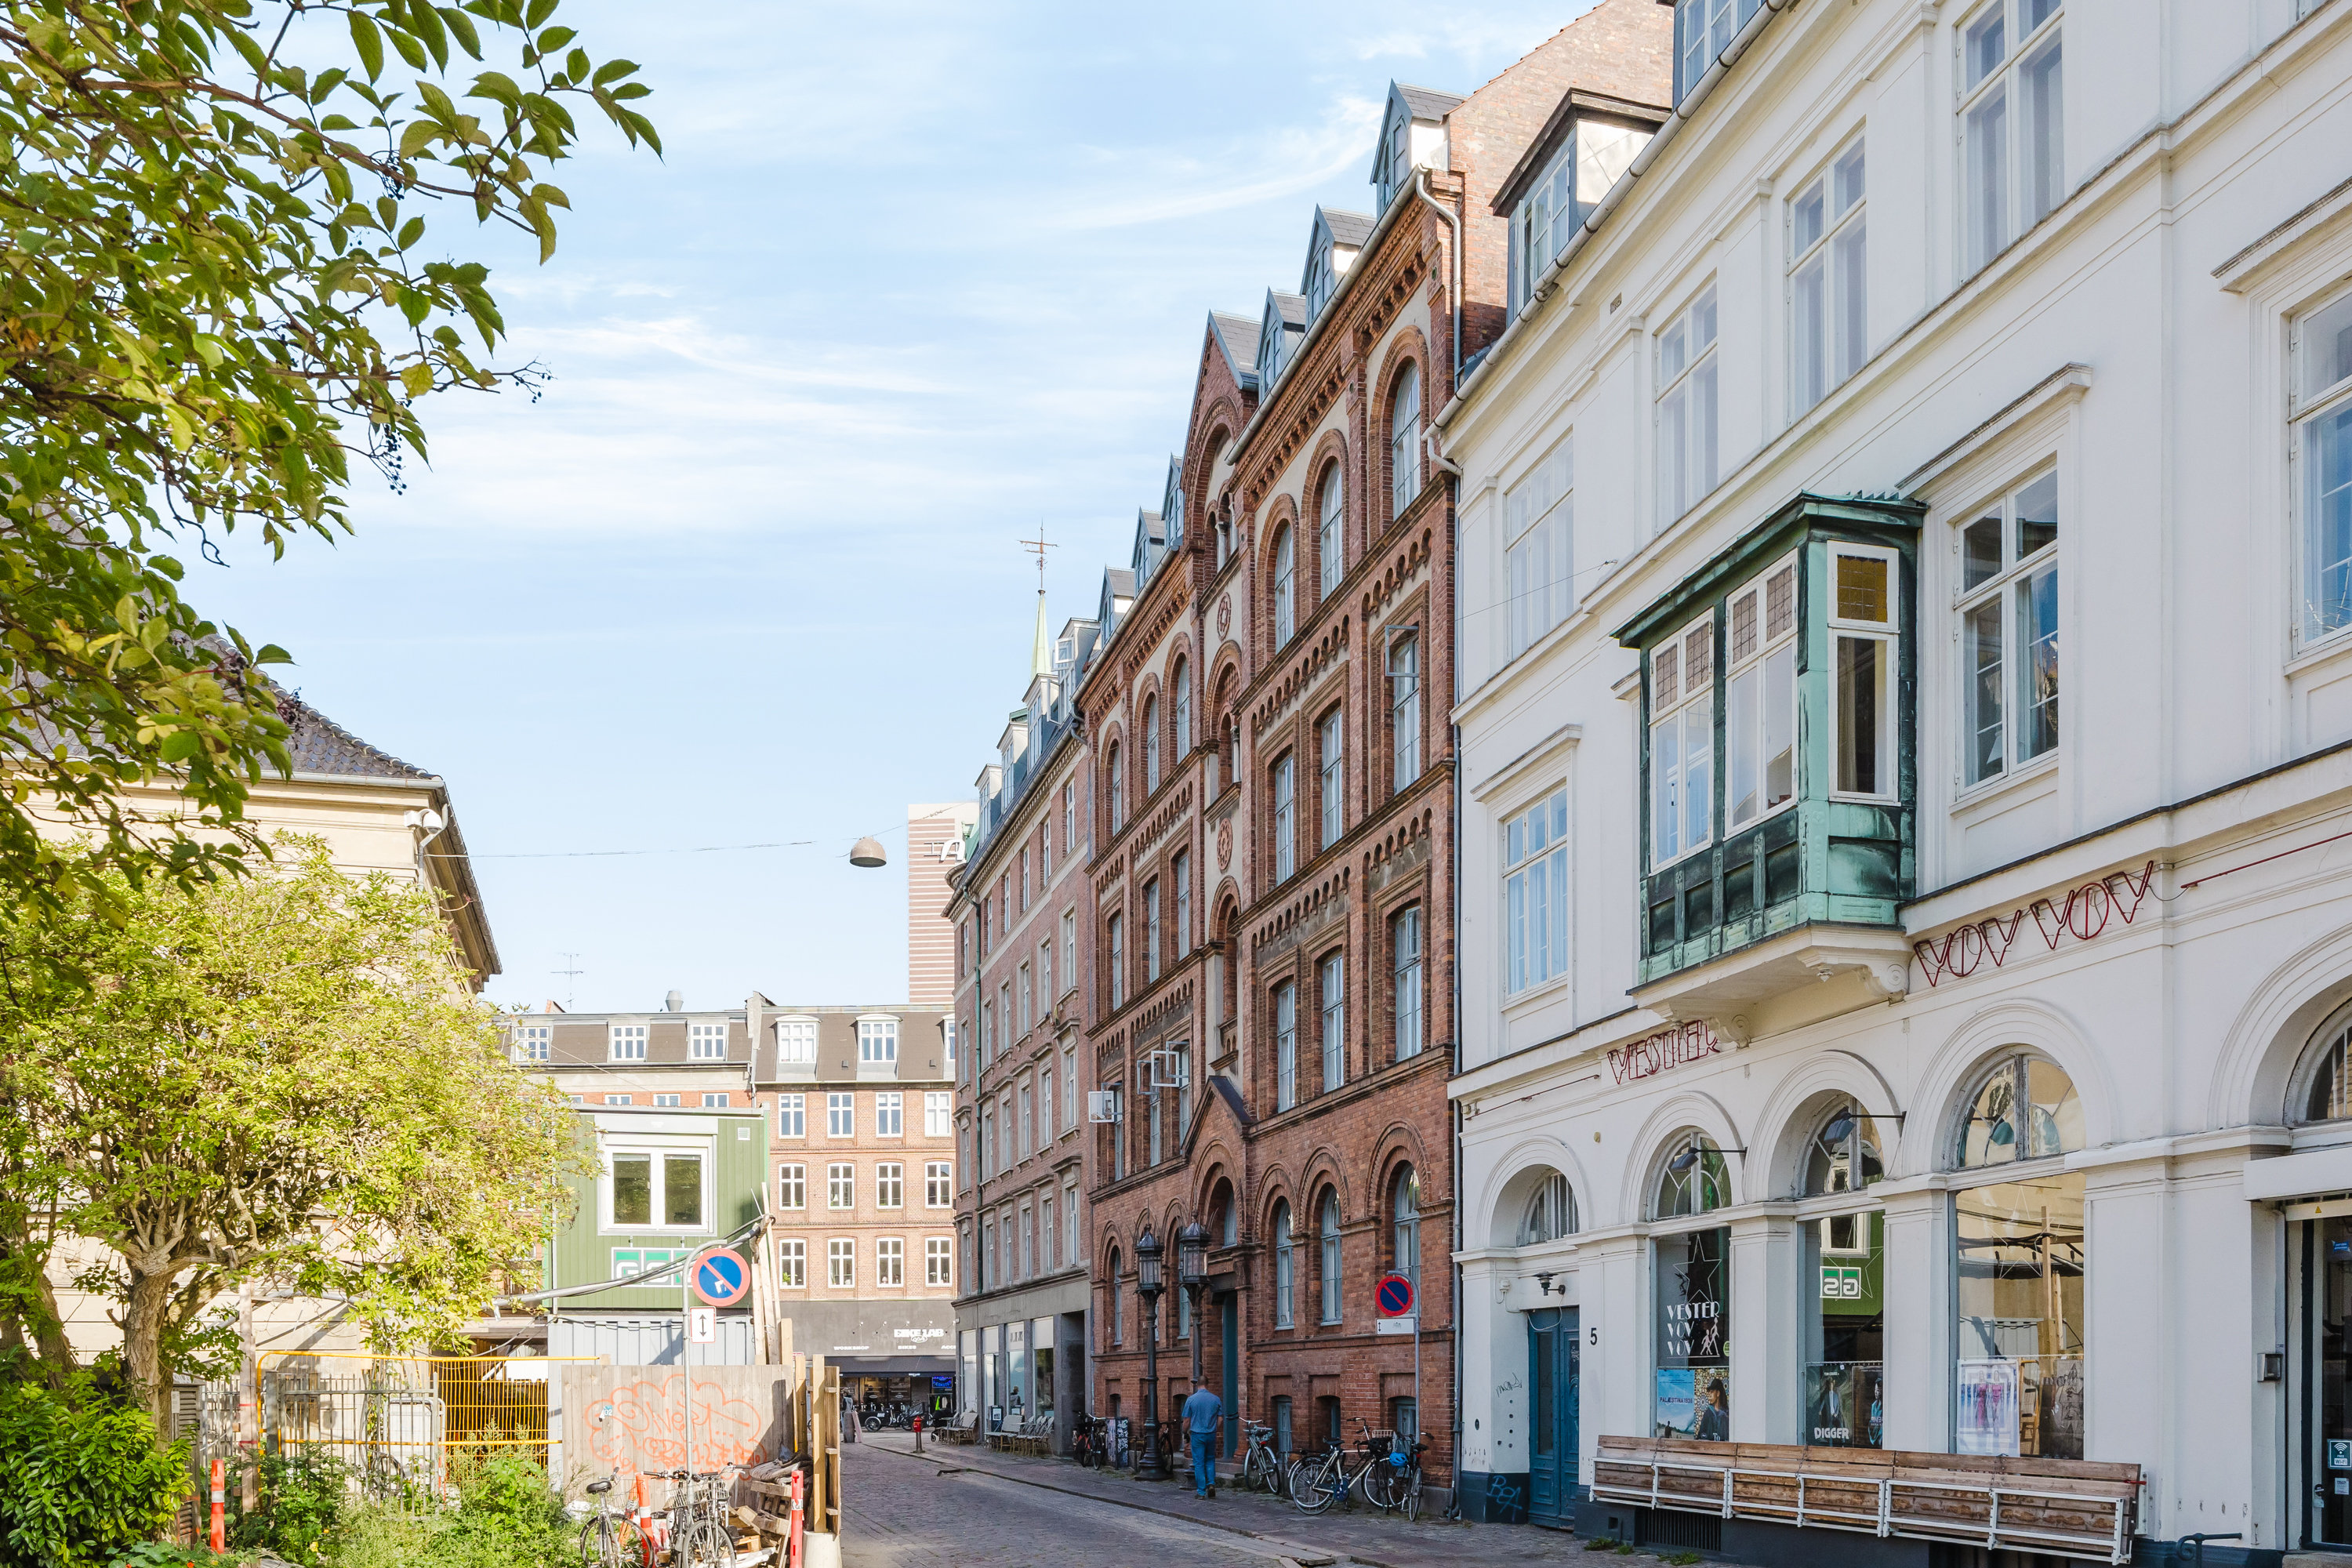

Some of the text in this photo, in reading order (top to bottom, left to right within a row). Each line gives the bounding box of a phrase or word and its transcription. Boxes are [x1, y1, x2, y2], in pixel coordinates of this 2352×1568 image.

[1914, 909, 2022, 987] VOV
[2030, 860, 2154, 949] VOV
[1667, 1301, 1720, 1320] VESTER
[1590, 1327, 1598, 1345] 5
[1668, 1321, 1694, 1338] VOV
[1668, 1339, 1694, 1356] VOV
[1813, 1428, 1849, 1439] DIGGER
